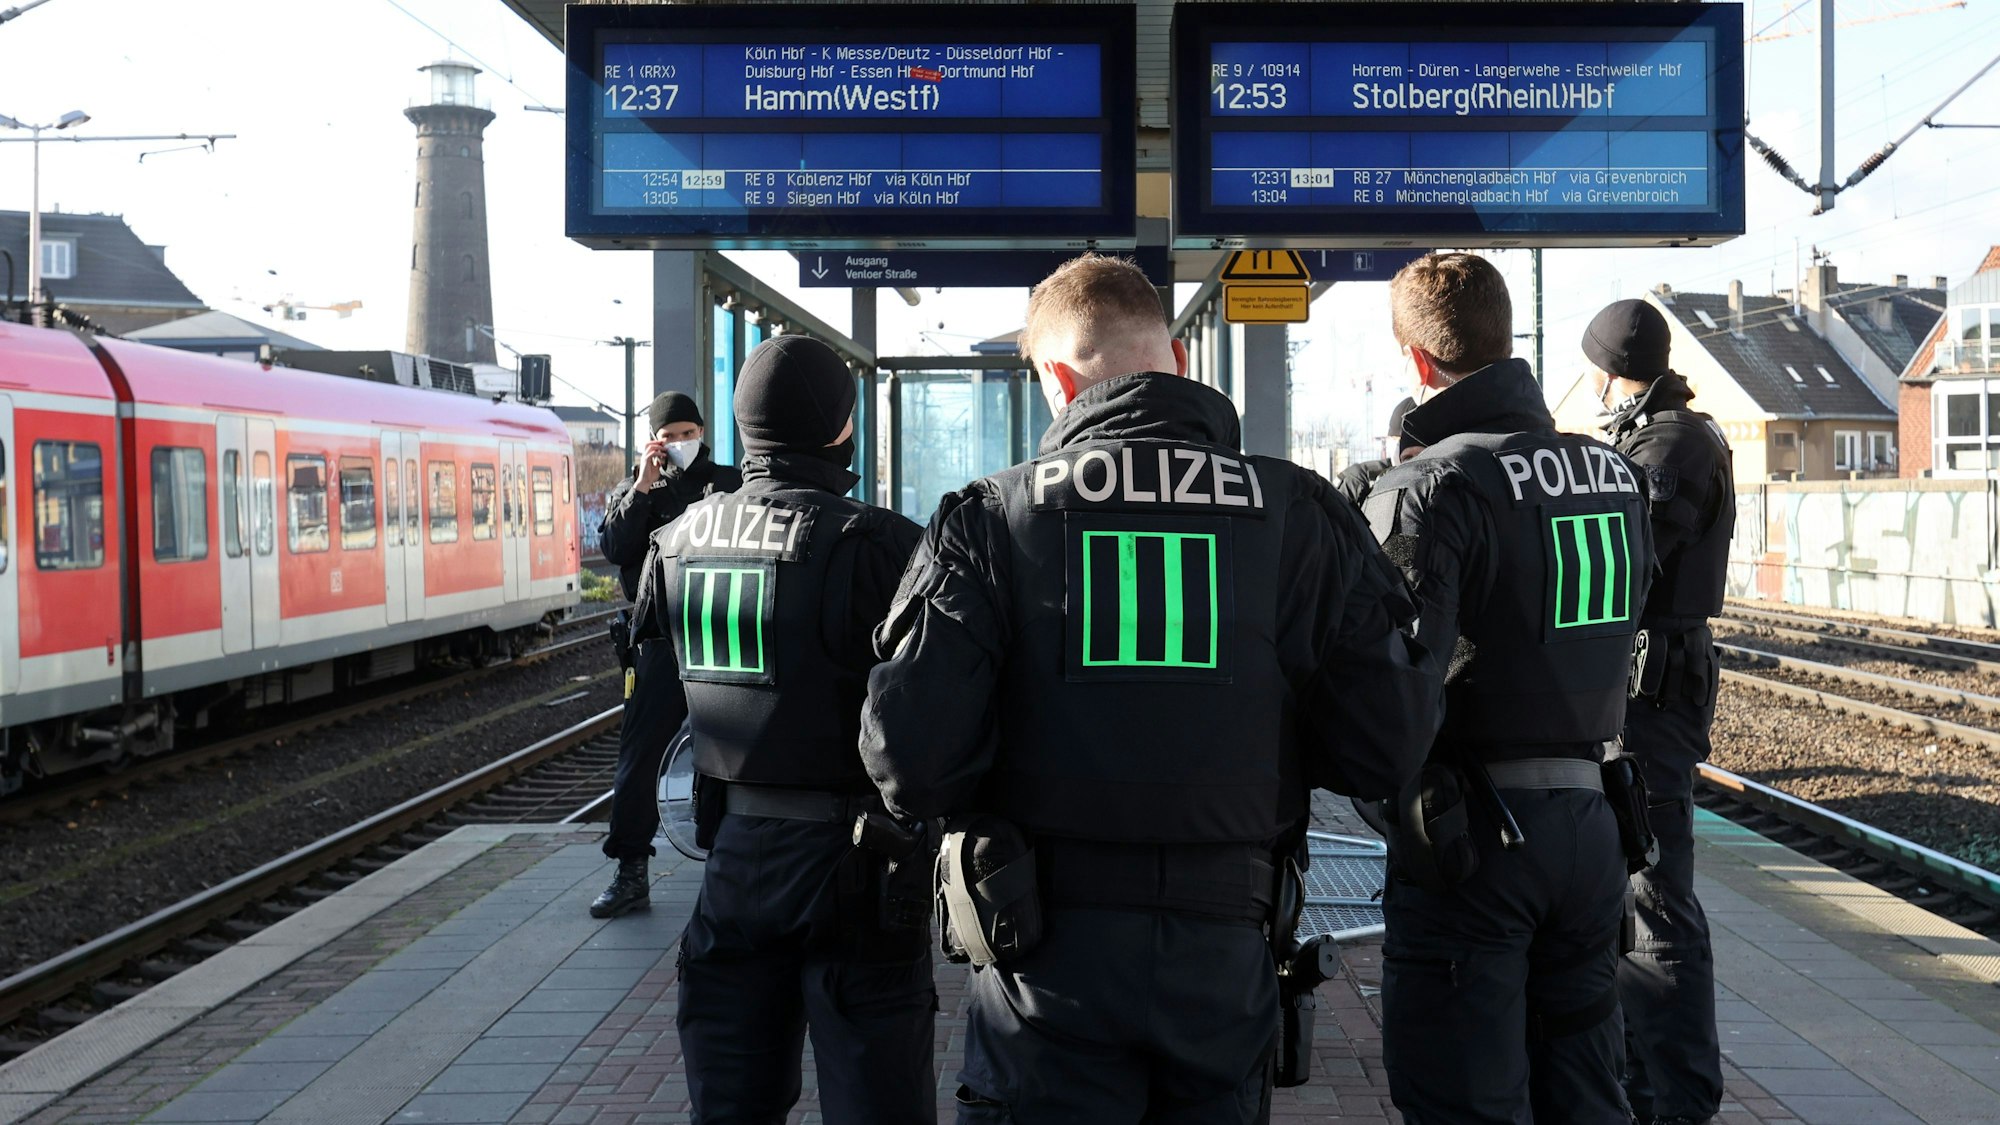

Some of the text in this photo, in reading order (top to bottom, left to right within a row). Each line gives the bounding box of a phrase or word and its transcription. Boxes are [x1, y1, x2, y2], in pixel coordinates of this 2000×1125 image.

[745, 47, 777, 60] Köln
[781, 47, 805, 60] Hbf
[822, 47, 832, 60] K
[836, 47, 930, 60] Messe/Deutz
[946, 47, 1024, 60] Düsseldorf
[1028, 47, 1053, 60] Hbf
[604, 65, 676, 79] RE 1 (RRX)
[745, 65, 806, 80] Duisburg
[810, 65, 835, 78] Hbf
[851, 65, 892, 78] Essen
[938, 65, 1007, 78] Dortmund
[1011, 65, 1035, 78] Hbf
[1212, 64, 1228, 76] RE
[1233, 64, 1242, 76] 9
[1261, 64, 1300, 76] 10914
[1353, 64, 1401, 76] Horrem
[1419, 64, 1459, 76] Düren
[1475, 64, 1560, 79] Langerwehe
[1576, 64, 1653, 76] Eschweiler
[1659, 64, 1682, 76] Hbf
[605, 84, 679, 111] 12:37
[745, 84, 940, 111] Hamm(Westf)
[1212, 83, 1287, 109] 12:53
[1352, 83, 1615, 116] Stolberg(Rheinl)Hbf
[643, 173, 971, 186] 12:54 12:59 RE 8 Koblenz Hbf via Köln Hbf
[1251, 171, 1687, 186] 12:31 13:01 RB 27 Mönchengladbach Hbf via Grevenbroich
[643, 191, 960, 206] 13:05 RE 9 Siegen Hbf via Köln Hbf
[1251, 190, 1679, 204] 13:04 RE 8 Mönchengladbach Hbf via Grevenbroich
[845, 256, 888, 267] Ausgang
[845, 269, 917, 279] Venloer Straße
[1034, 447, 1264, 508] POLIZEI
[1499, 446, 1639, 500] POLIZEI
[670, 504, 804, 551] POLIZEI
